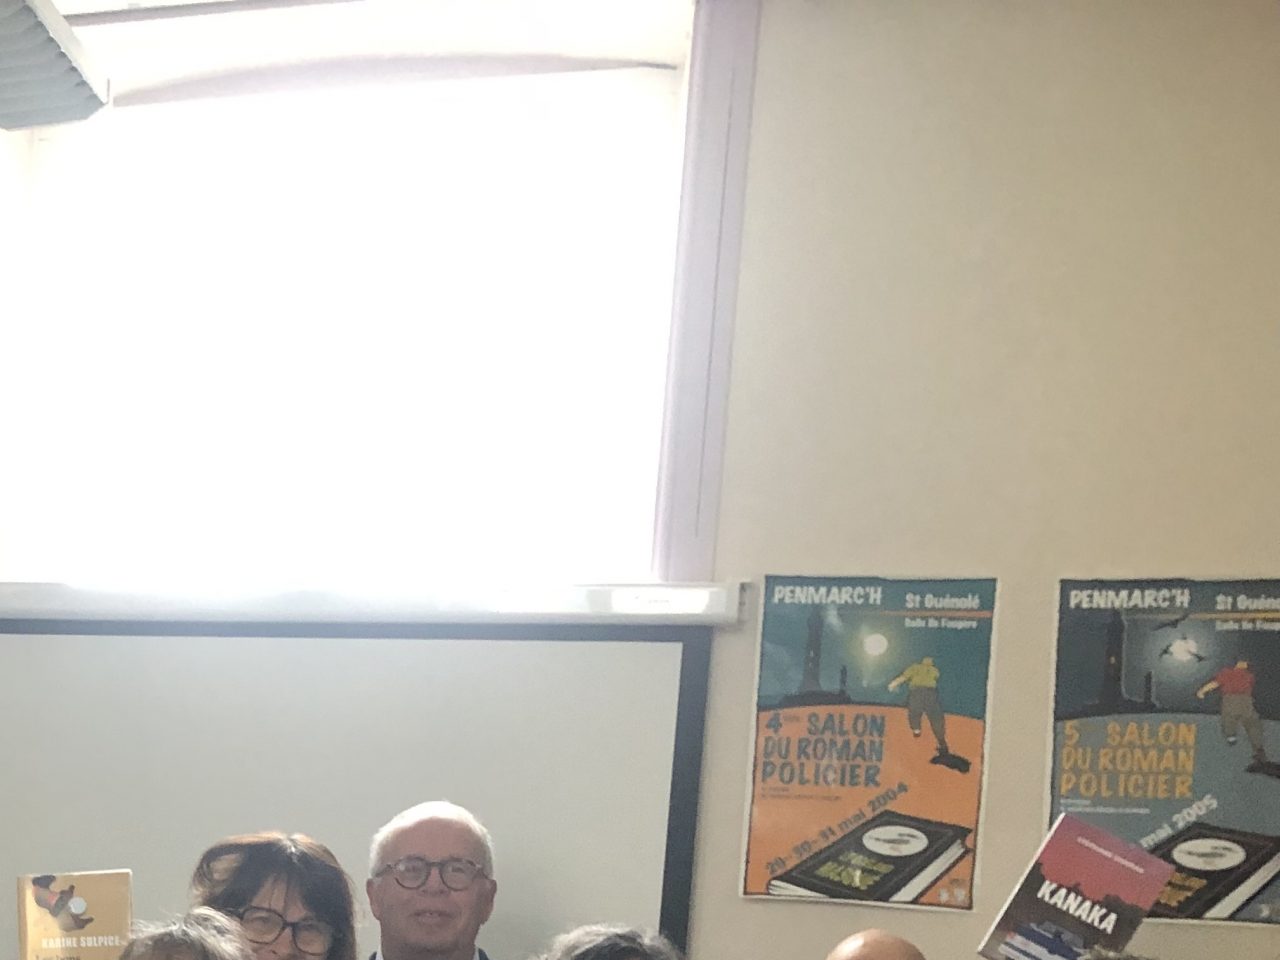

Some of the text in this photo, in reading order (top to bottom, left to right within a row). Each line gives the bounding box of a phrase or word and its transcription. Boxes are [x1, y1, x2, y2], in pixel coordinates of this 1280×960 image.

[773, 585, 882, 605] PENMARC'H
[1068, 588, 1190, 609] PENMARC'H
[808, 713, 886, 736] SALON
[1107, 723, 1196, 745] SALON
[763, 736, 885, 762] DU ROMAN
[1060, 747, 1196, 773] DU ROMAN
[761, 761, 881, 787] POLICIER
[1059, 772, 1194, 799] POLICIER
[1036, 879, 1118, 935] KANAKA
